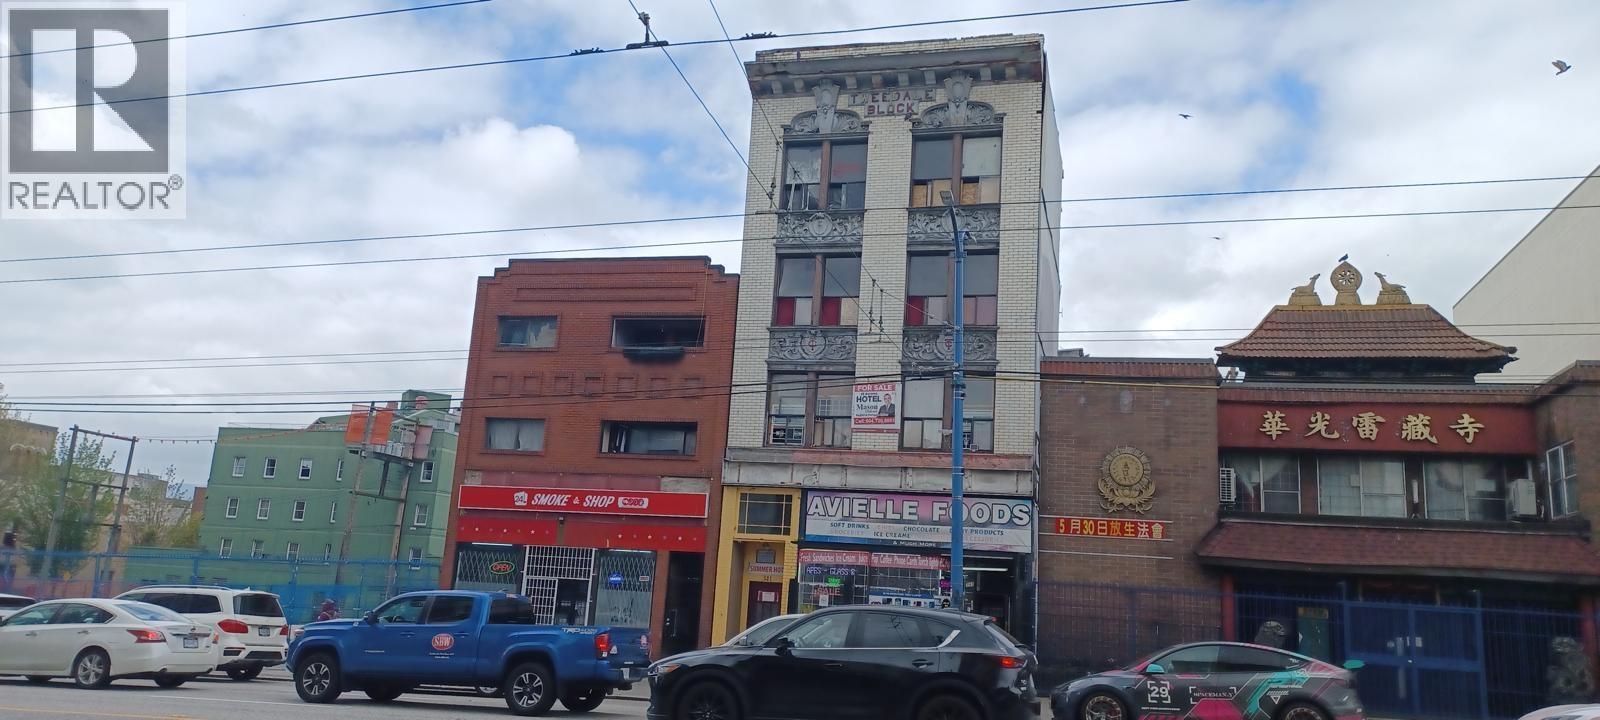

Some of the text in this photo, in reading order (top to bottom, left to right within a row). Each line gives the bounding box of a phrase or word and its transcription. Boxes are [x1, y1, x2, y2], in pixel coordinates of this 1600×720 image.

[850, 89, 933, 103] TEEDAE
[867, 103, 914, 114] BLOCK
[1259, 410, 1485, 444] 華光雷藏寺
[531, 494, 571, 506] SMOKE
[573, 496, 580, 504] &
[583, 495, 615, 508] SHOP
[807, 496, 919, 520] AVIELLE
[492, 562, 511, 572] OPEN
[1150, 686, 1169, 697] 29
